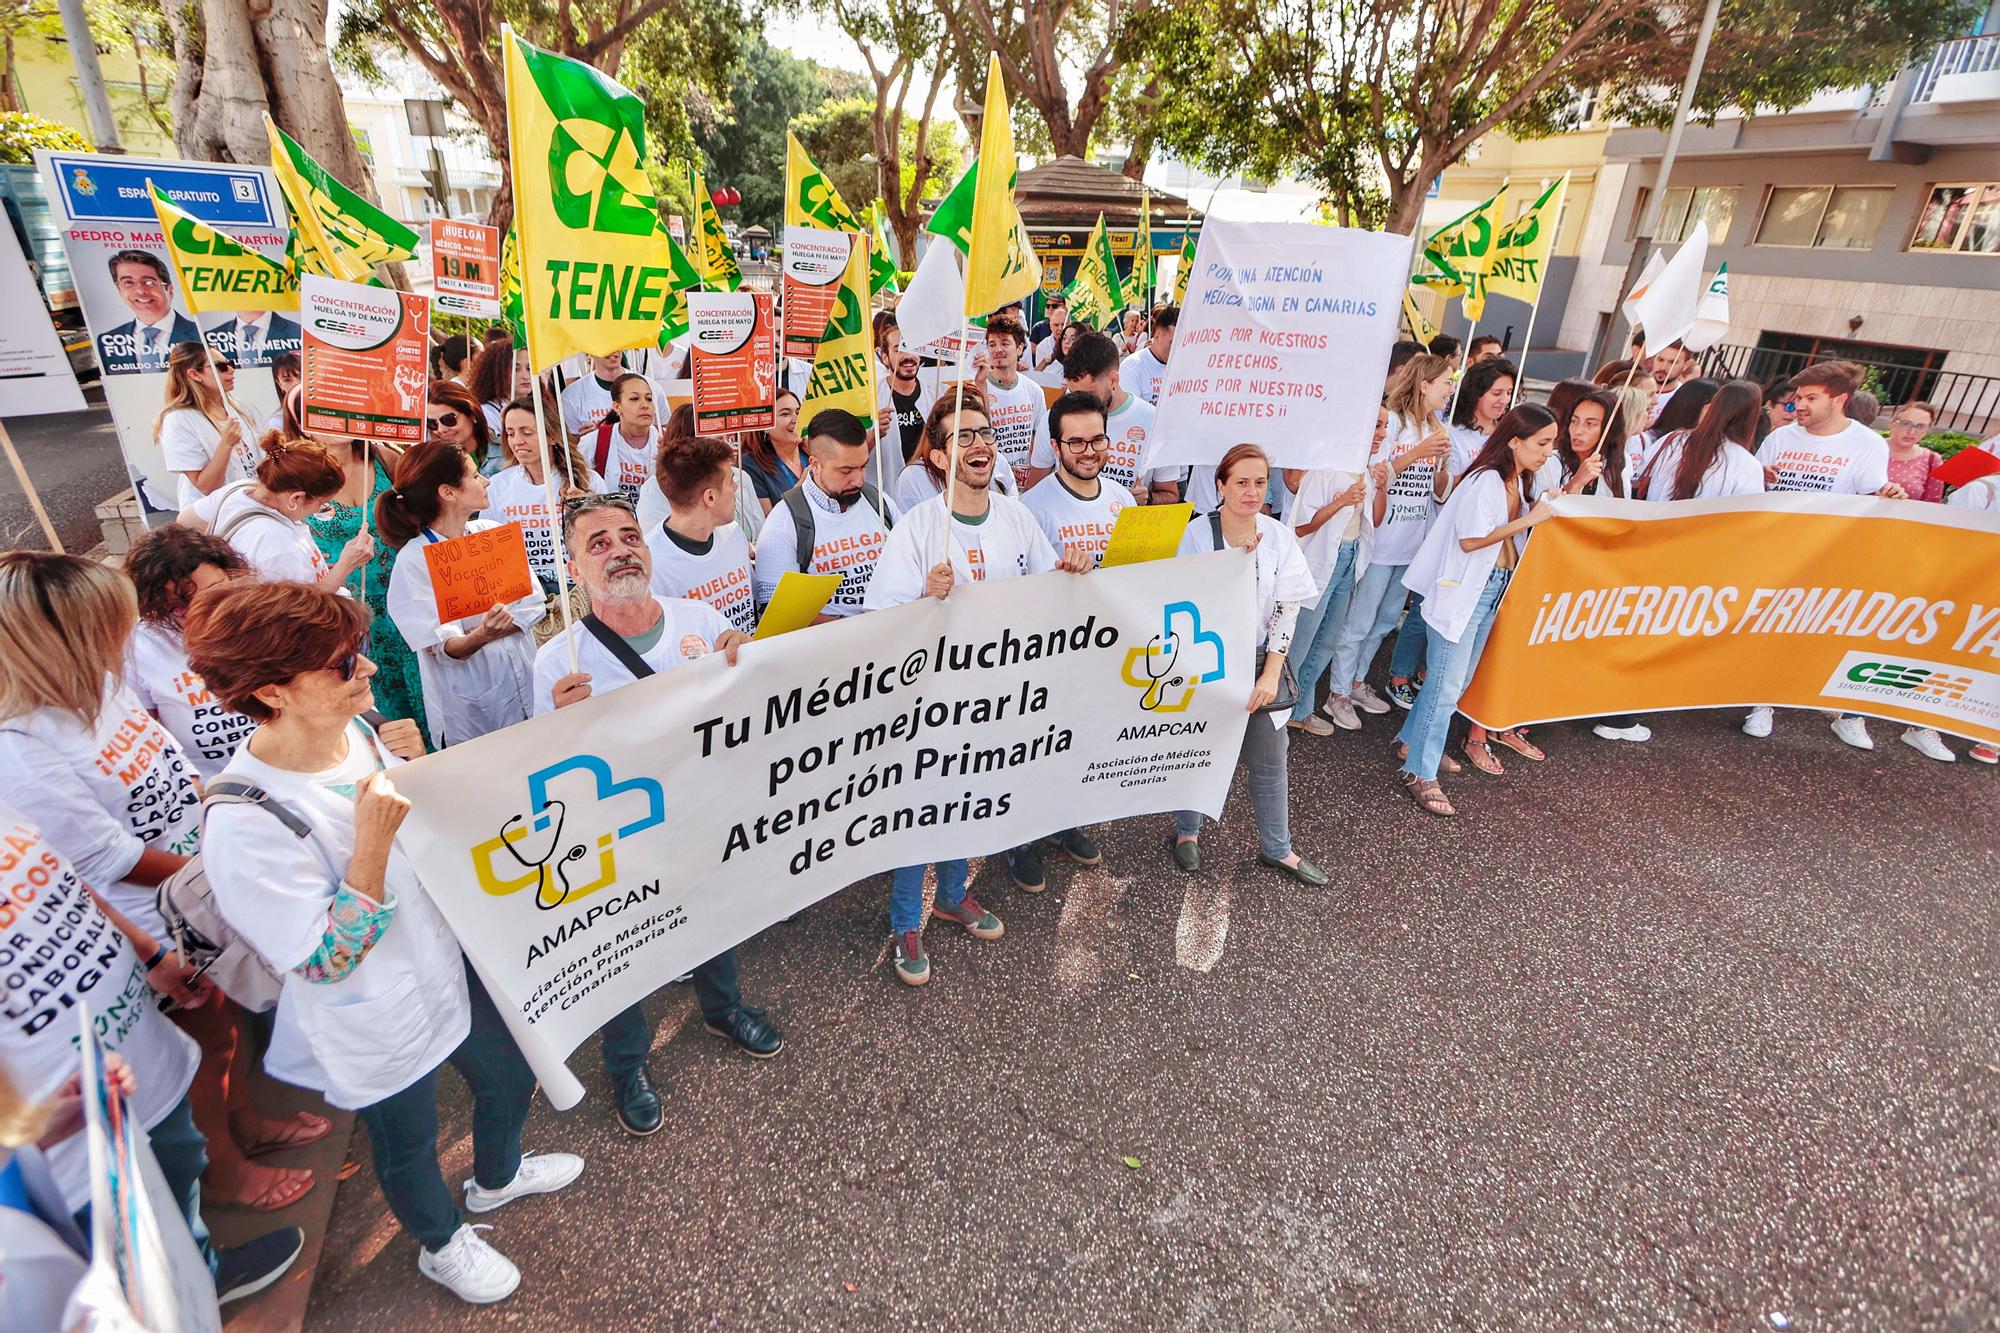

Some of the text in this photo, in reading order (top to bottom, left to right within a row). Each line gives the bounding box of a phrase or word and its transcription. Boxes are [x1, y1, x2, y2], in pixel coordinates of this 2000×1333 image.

[168, 187, 220, 203] GRATUITO
[240, 186, 250, 198] 3
[71, 230, 124, 242] PEDRO
[442, 225, 485, 242] ¡HUELGA!
[104, 242, 163, 250] PRESIDENTE
[790, 242, 847, 254] CONCENTRACIÓN
[1206, 263, 1232, 282] POR
[1238, 268, 1256, 284] UNA
[1264, 260, 1323, 283] ATENCIÓN
[311, 294, 396, 316] CONCENTRACIÓN
[1202, 284, 1377, 317] MÉDICA DIGNA EN CANARIAS
[314, 305, 346, 316] HUELGA
[370, 315, 394, 325] MAYO
[695, 308, 752, 318] CONCENTRACIÓN
[101, 334, 136, 346] CON
[1182, 327, 1327, 350] UNIDOS POR NUESTROS
[110, 361, 171, 371] CABILDO 202
[1207, 353, 1284, 373] DERECHOS,
[1169, 378, 1209, 397] UNIDOS
[1215, 379, 1242, 393] POR
[1249, 379, 1328, 402] NUESTROS,
[1200, 402, 1274, 418] PACIENTES
[356, 422, 366, 430] 19
[1777, 451, 1849, 467] ¡HUELGA!
[1128, 510, 1168, 526] STOP
[430, 541, 462, 565] NO
[464, 533, 493, 557] ES
[474, 576, 503, 595] Que
[724, 598, 751, 618] UNAS
[1528, 585, 1738, 646] ¡ACUERDOS
[1731, 586, 1950, 645] FIRMADOS
[693, 616, 1118, 758] Tu Médic@ luchando
[1847, 662, 1973, 699] CESM
[1838, 682, 1893, 696] SINDICATO
[1898, 690, 1941, 704] MÉDICO
[768, 680, 1048, 797] por mejorar la
[1116, 721, 1207, 742] AMAPCAN
[1088, 749, 1211, 771] Asociación de Médicos
[1081, 759, 1211, 784] de Atención Primaria de
[1120, 776, 1167, 788] Canarias
[721, 724, 1072, 862] Atención Primaria
[789, 792, 1011, 876] de Canarias
[32, 870, 76, 926] UNAS
[526, 879, 660, 969] AMAPCAN
[592, 942, 612, 957] de
[616, 904, 682, 945] Médicos
[597, 927, 665, 970] Primaria
[669, 915, 688, 930] de
[561, 961, 630, 1011] Canarias
